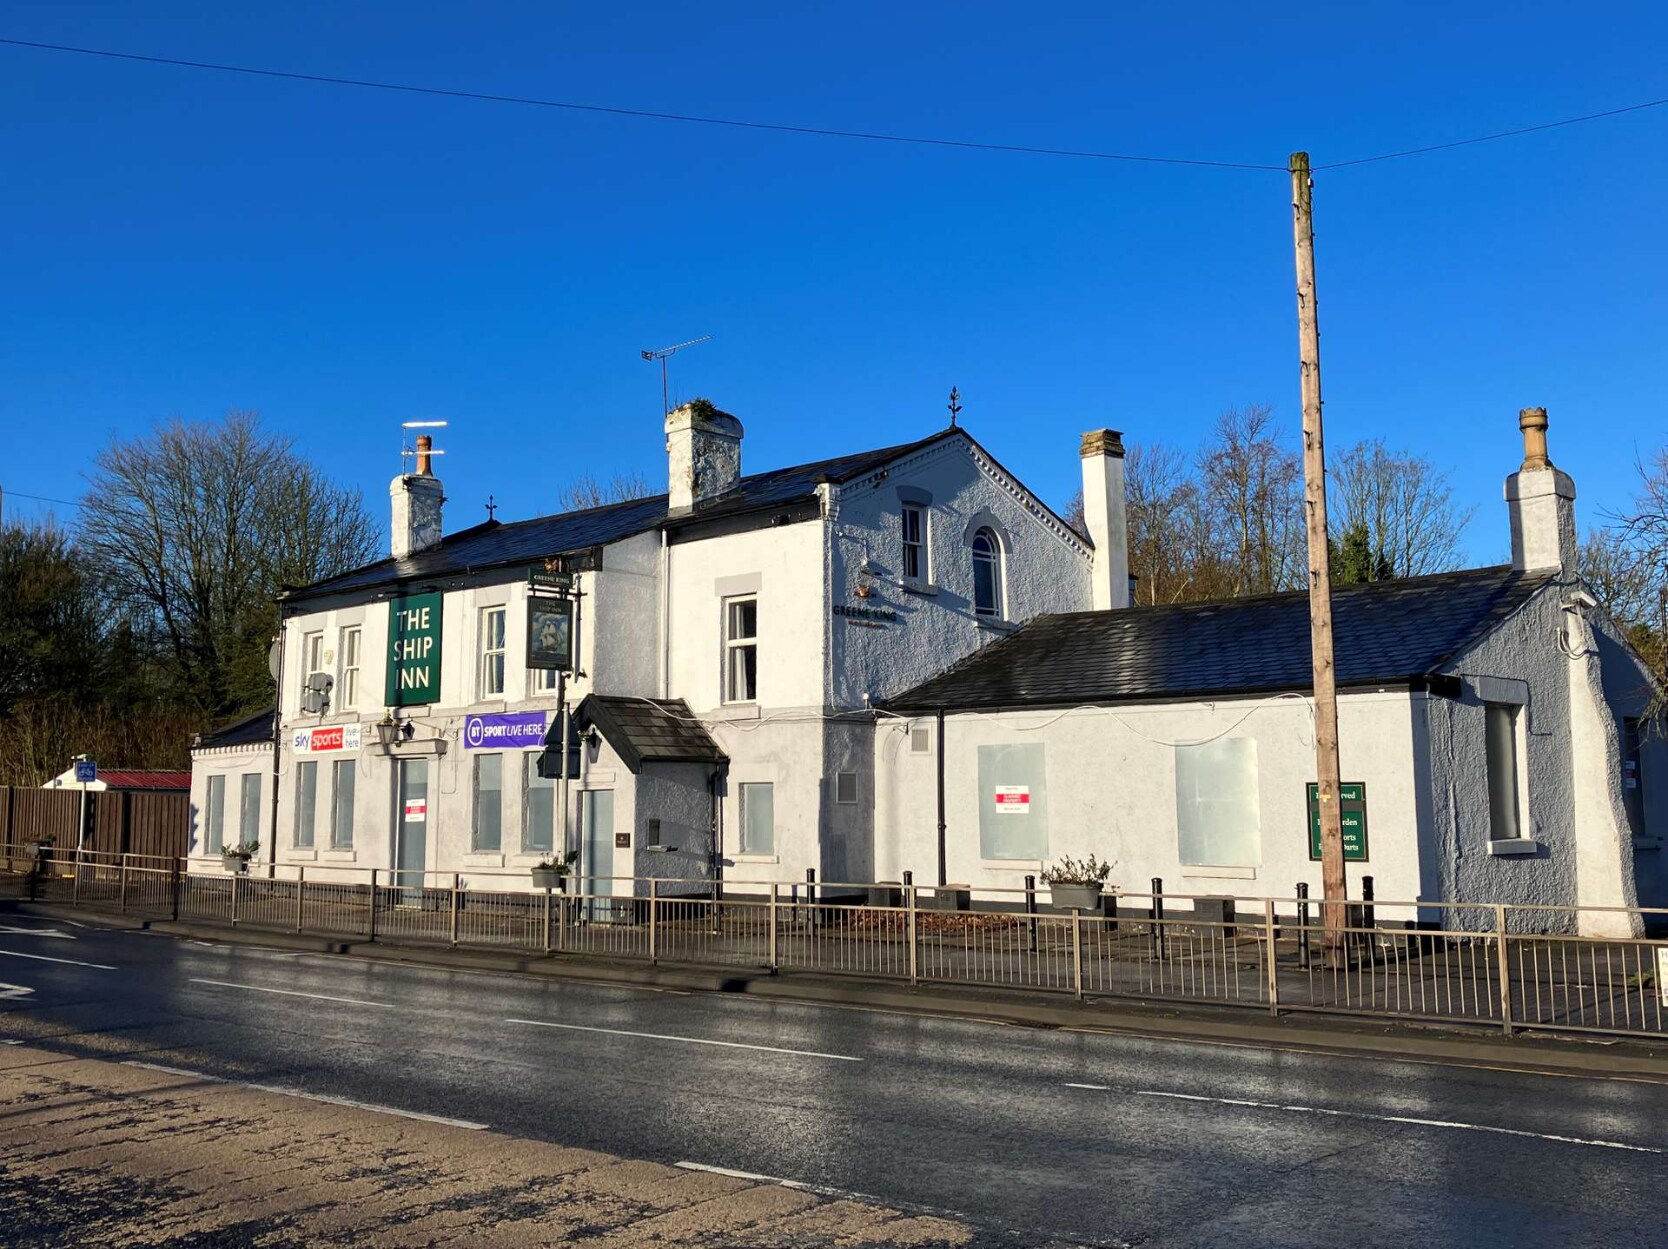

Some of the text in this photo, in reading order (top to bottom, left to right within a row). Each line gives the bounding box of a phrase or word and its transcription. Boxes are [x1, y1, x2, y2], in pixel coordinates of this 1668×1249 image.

[396, 607, 430, 632] THE
[833, 605, 897, 622] GREENE KING
[393, 636, 433, 661] SHIP
[395, 665, 429, 689] INN
[471, 723, 543, 737] BT SPORT LIVE HERE
[295, 732, 341, 750] sky sports
[345, 739, 359, 748] here
